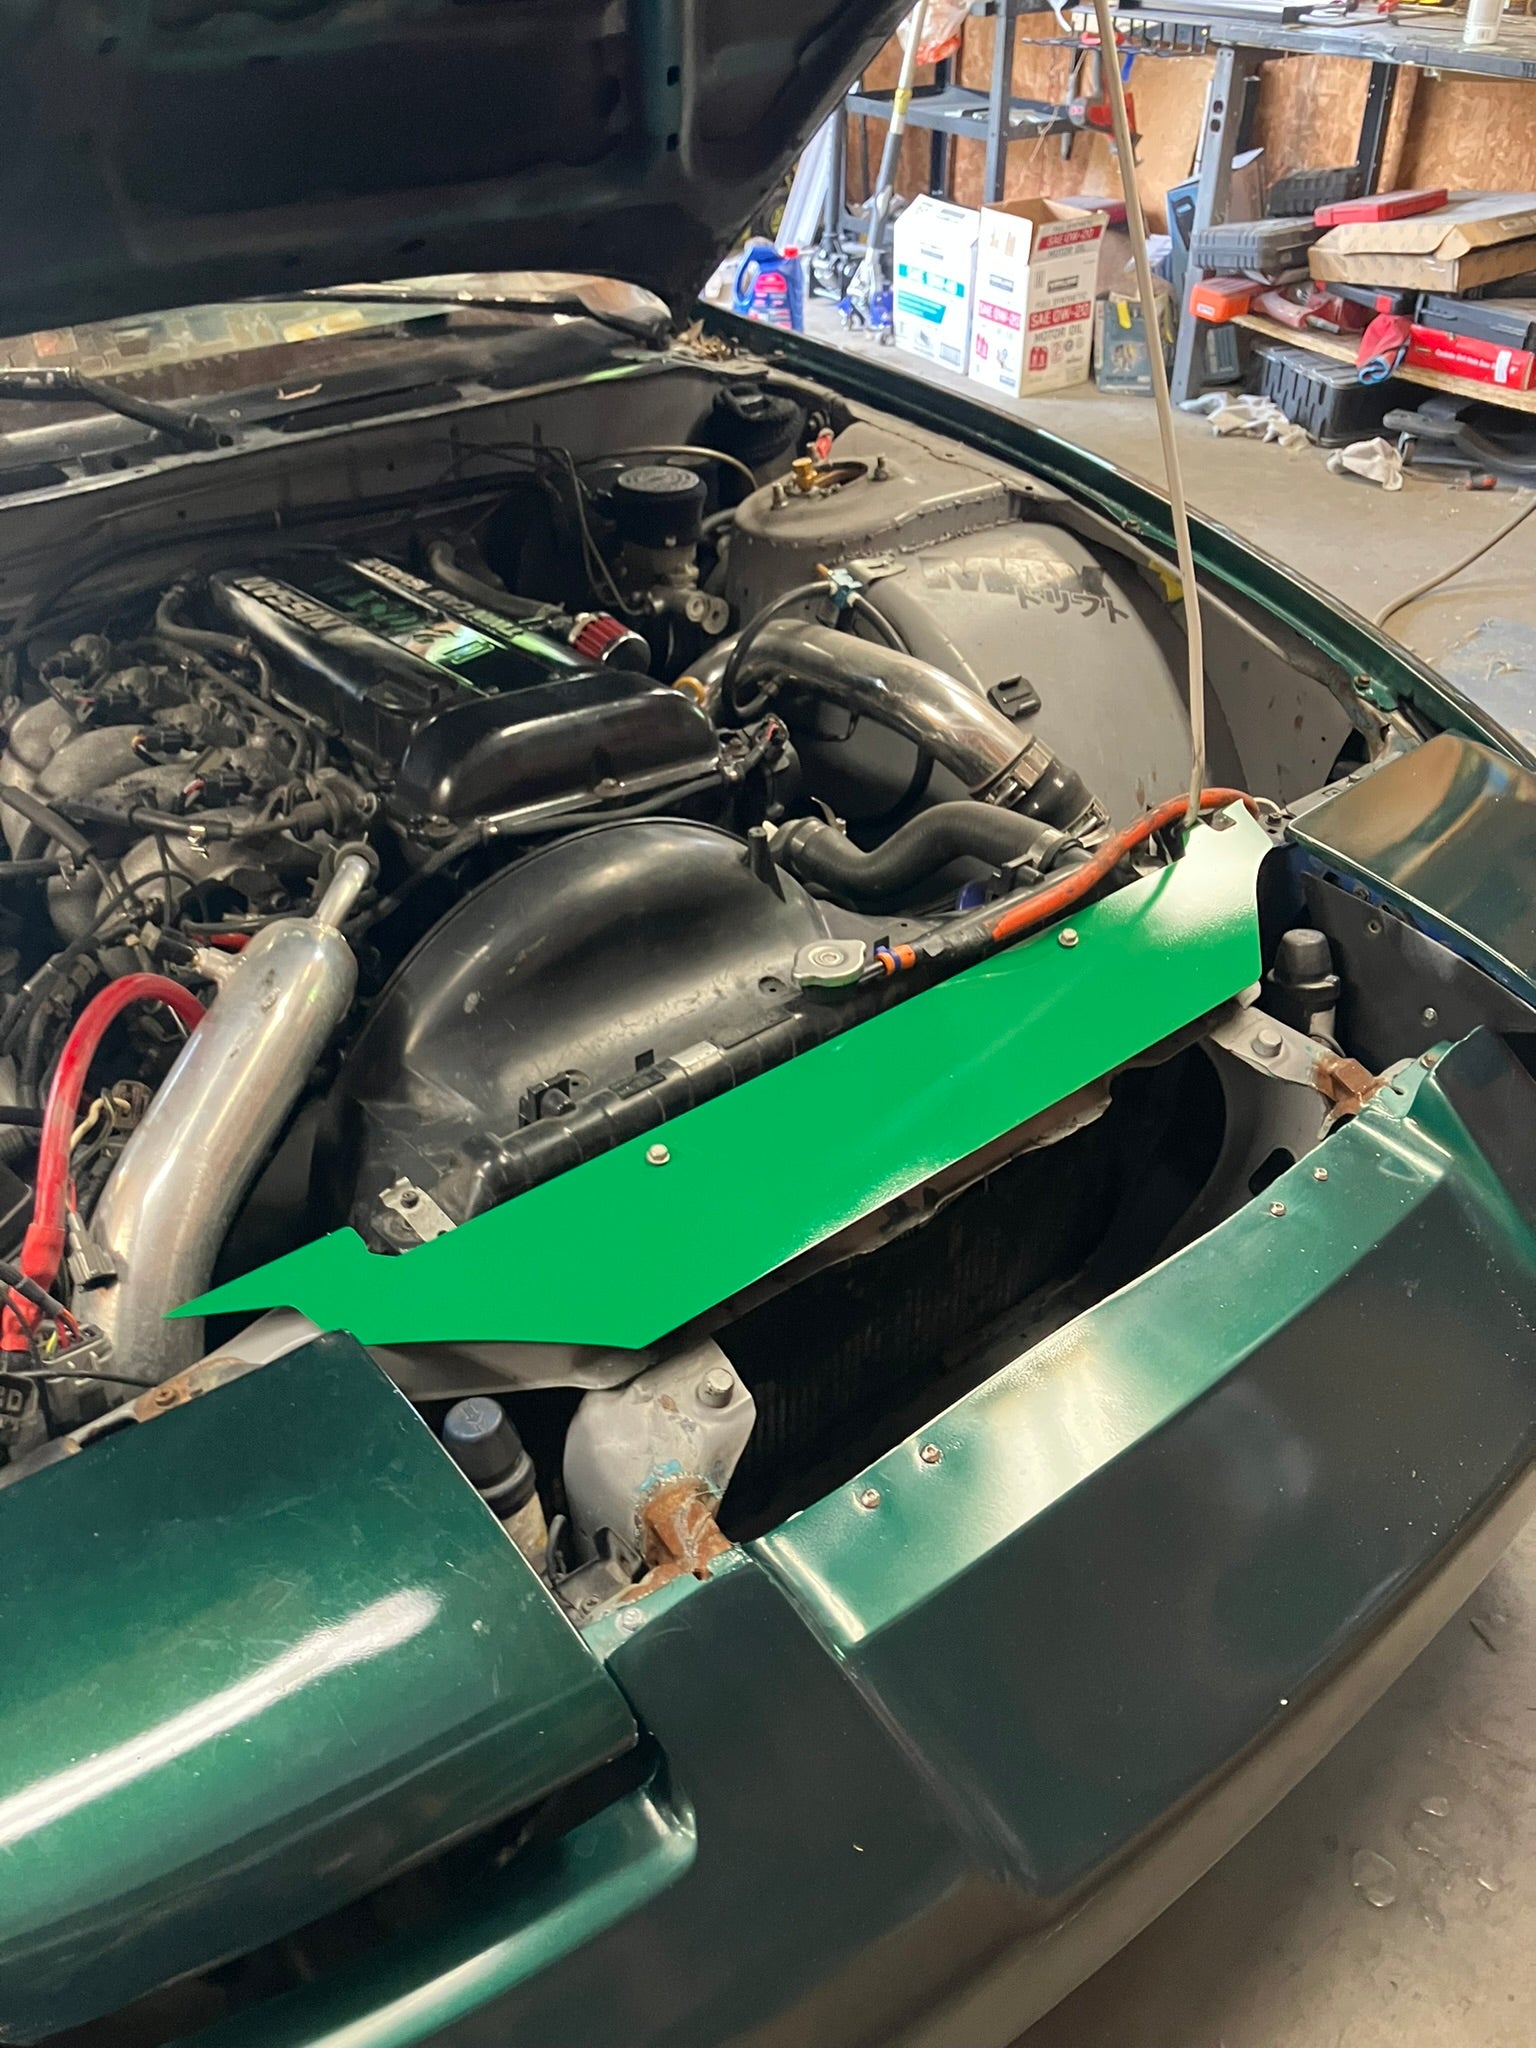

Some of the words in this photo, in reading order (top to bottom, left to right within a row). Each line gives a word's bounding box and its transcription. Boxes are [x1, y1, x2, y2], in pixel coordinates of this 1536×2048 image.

[1030, 311, 1053, 328] SAE
[1052, 302, 1090, 323] 0W-20
[1034, 327, 1066, 342] MOTOR
[1068, 323, 1083, 336] OIL
[233, 576, 352, 631] NISSAN
[1015, 585, 1130, 625] ドリフト
